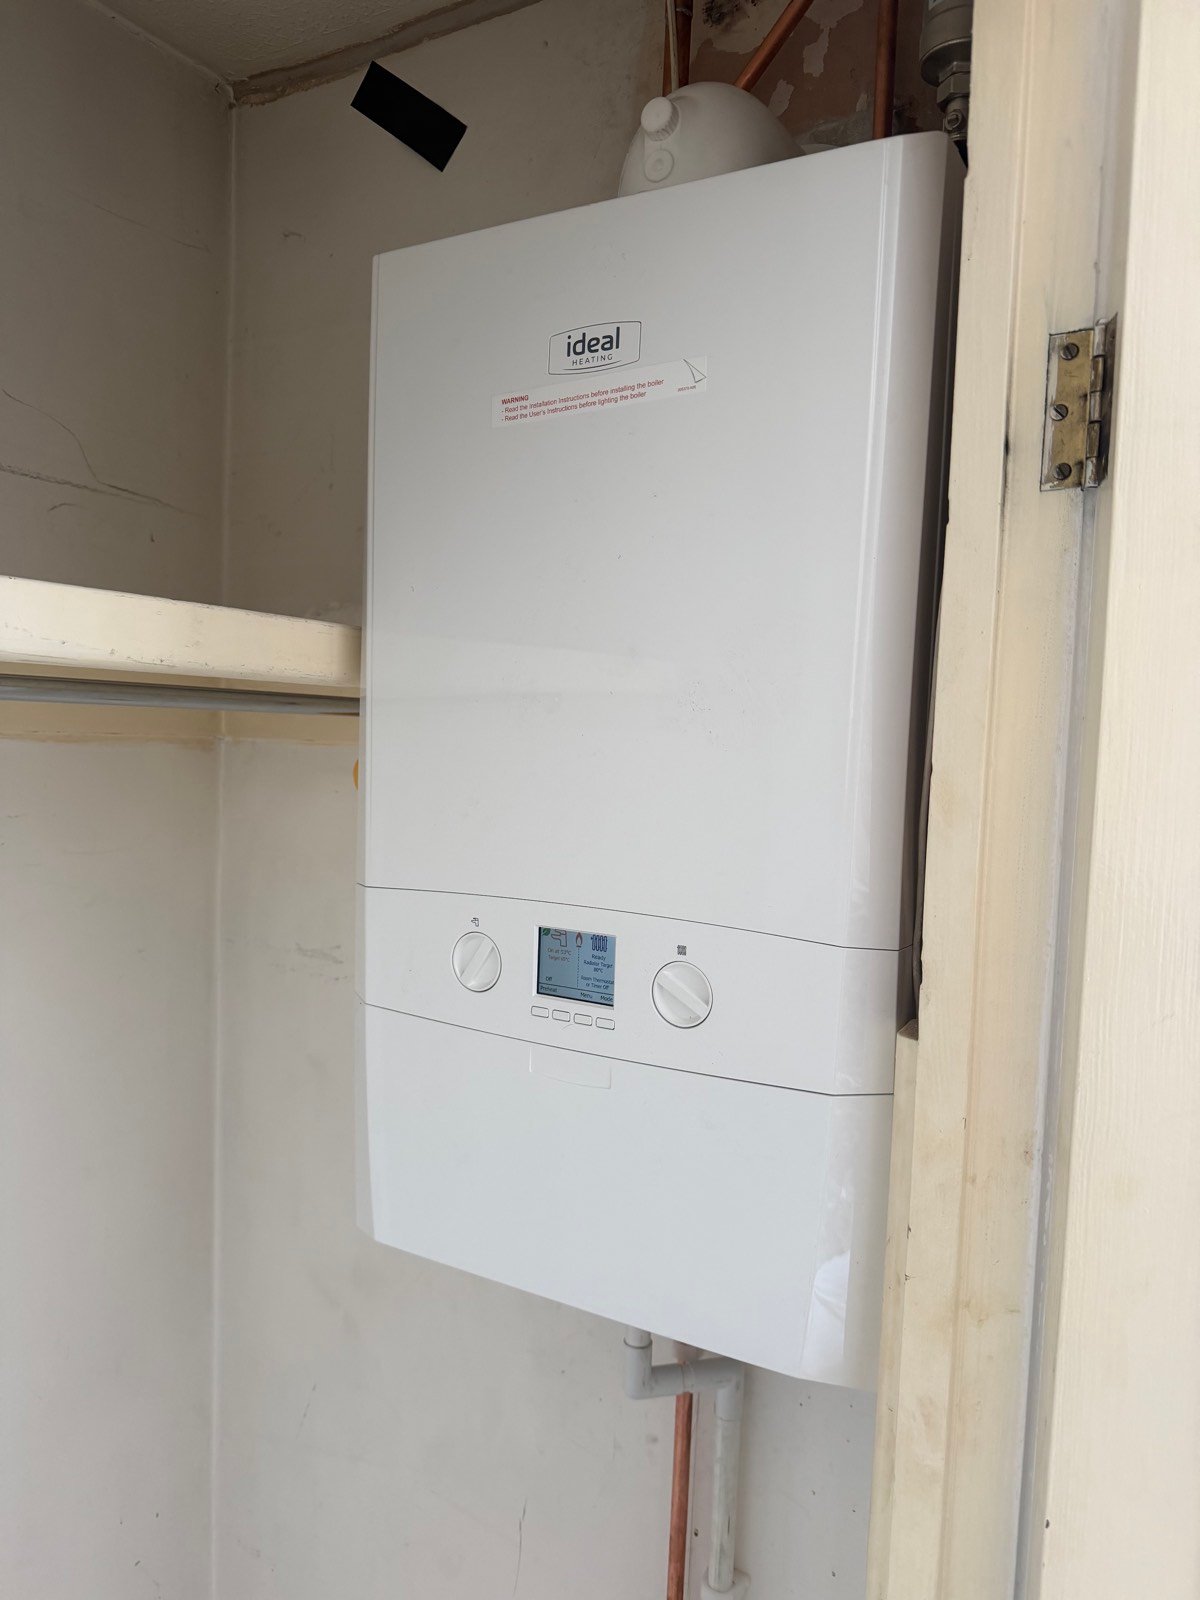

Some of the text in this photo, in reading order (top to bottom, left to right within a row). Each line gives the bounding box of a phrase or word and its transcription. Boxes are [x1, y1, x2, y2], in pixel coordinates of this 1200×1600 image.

[566, 326, 621, 357] ideal
[572, 354, 613, 366] HEATING
[501, 394, 529, 405] WARNING
[504, 414, 518, 422] Read
[529, 408, 546, 418] User's
[547, 403, 578, 415] Instructions
[578, 400, 597, 409] before
[597, 396, 619, 406] lighting
[619, 393, 629, 401] the
[629, 391, 647, 400] boiler
[529, 399, 557, 409] Installation
[558, 392, 590, 403] Instructions
[590, 388, 609, 398] before
[610, 383, 636, 394] installing
[636, 381, 646, 389] the
[647, 379, 665, 388] boiler
